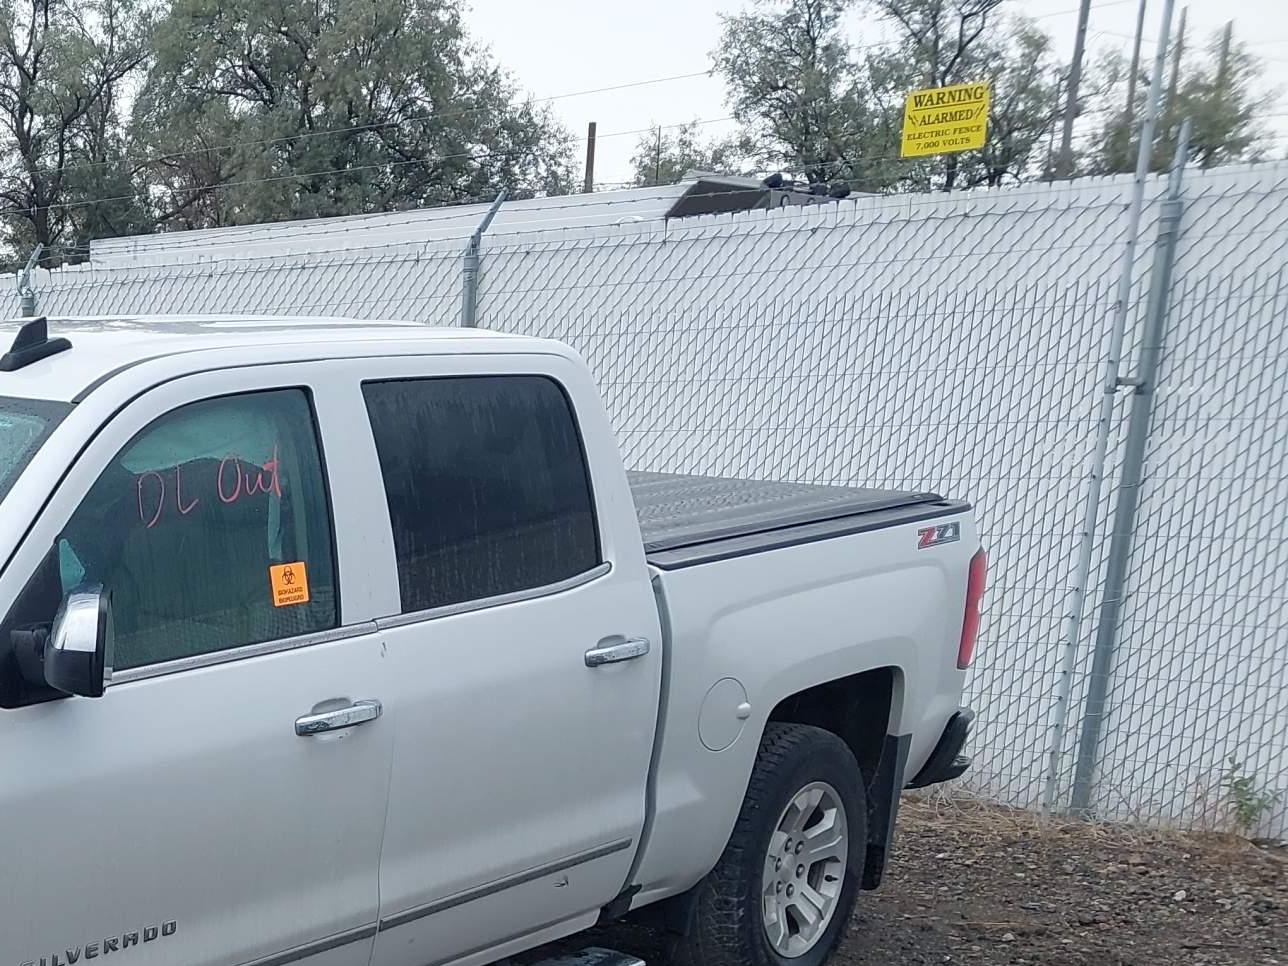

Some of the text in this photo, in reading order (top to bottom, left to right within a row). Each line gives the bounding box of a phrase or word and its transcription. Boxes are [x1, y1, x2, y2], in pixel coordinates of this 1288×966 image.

[913, 86, 985, 108] WARNING
[919, 109, 973, 126] ALARMED
[906, 125, 982, 140] ELECTRIC FENCE
[916, 137, 971, 150] 7,000 VOLTS
[217, 442, 281, 503] Out
[918, 521, 960, 549] Z71
